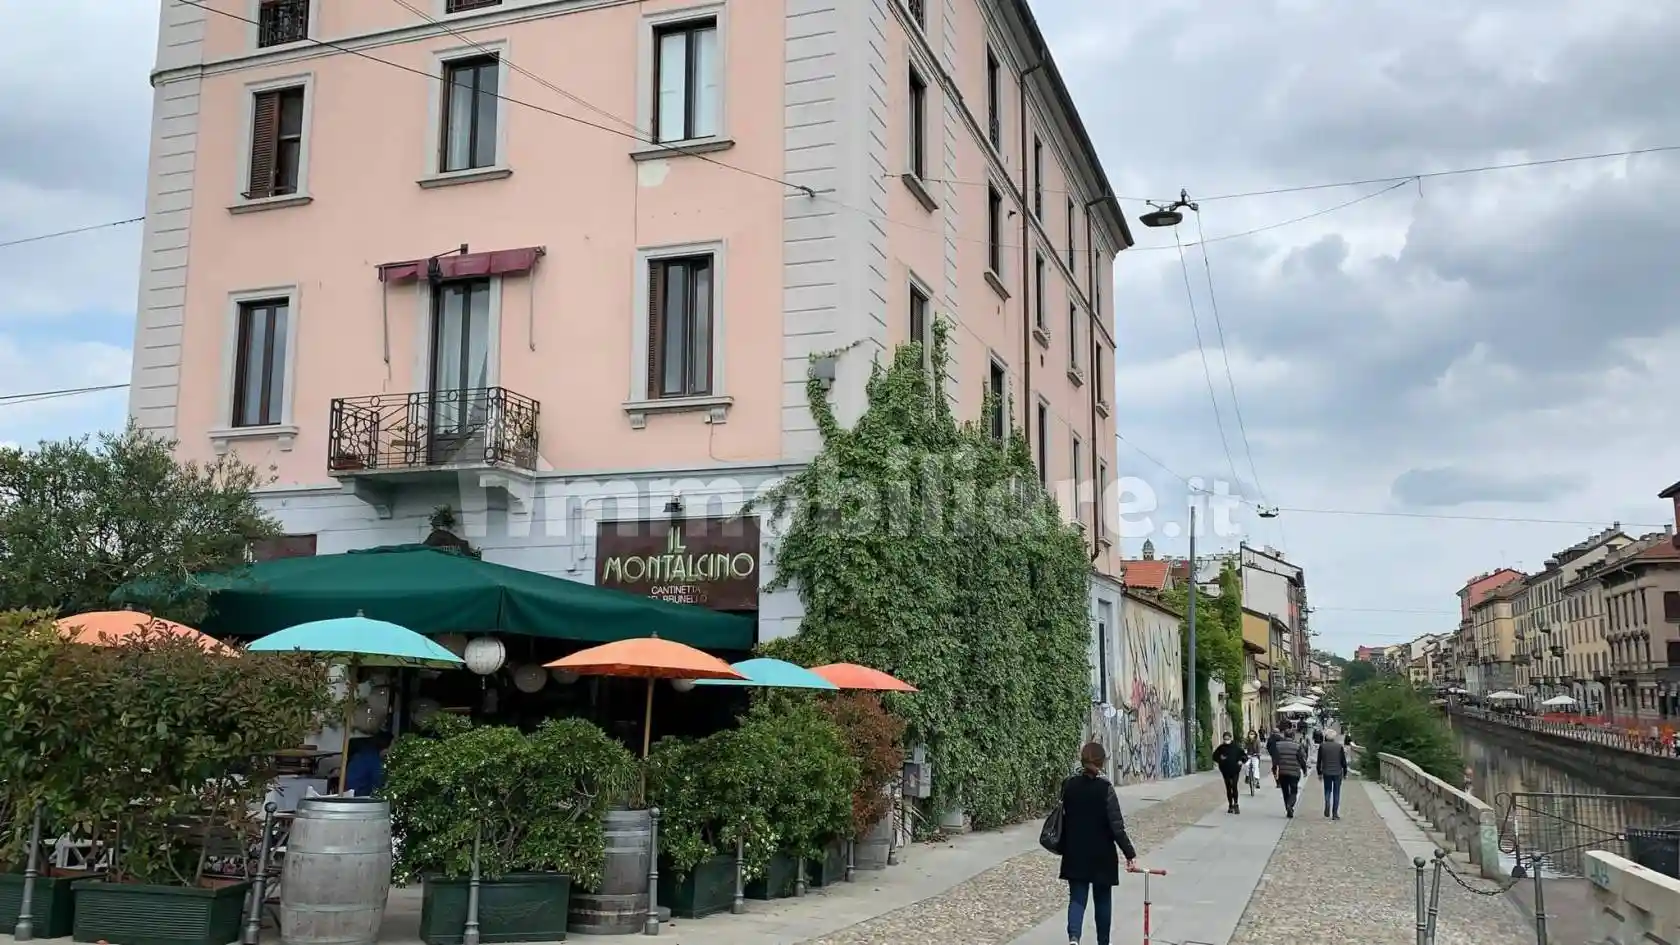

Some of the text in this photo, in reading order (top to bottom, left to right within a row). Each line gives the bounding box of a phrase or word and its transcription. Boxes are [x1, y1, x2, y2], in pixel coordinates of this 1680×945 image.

[667, 525, 687, 554] IL
[602, 552, 755, 584] MONTALCINO
[651, 585, 702, 596] CANTINETTA
